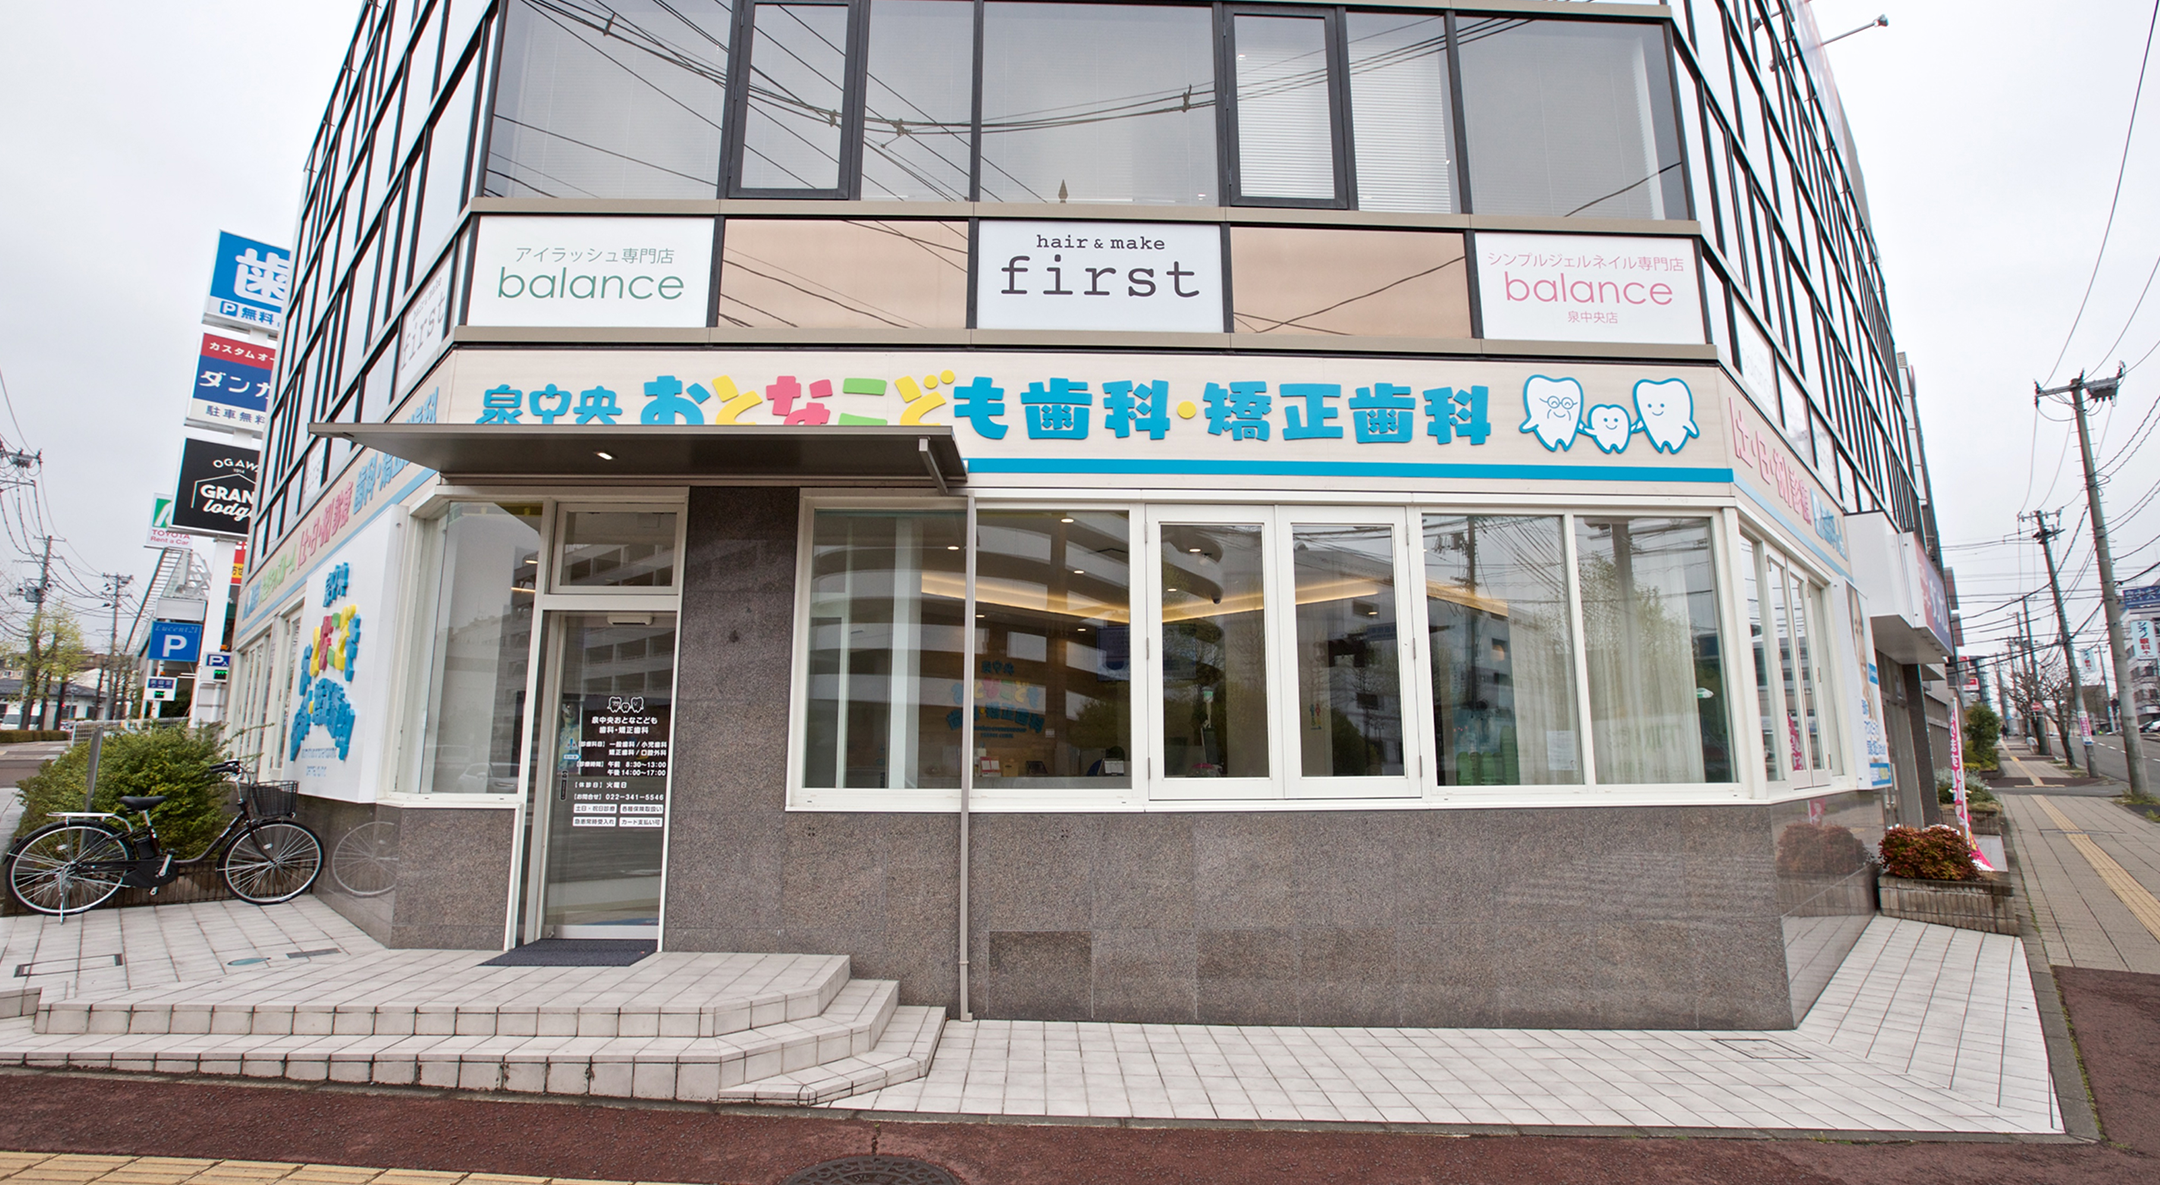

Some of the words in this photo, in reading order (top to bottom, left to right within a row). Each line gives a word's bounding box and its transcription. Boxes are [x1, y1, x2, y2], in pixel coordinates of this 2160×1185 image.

[1036, 234, 1088, 249] hair
[1093, 238, 1104, 249] &
[1110, 236, 1165, 250] make
[516, 247, 674, 264] アイラッシュ専門店
[1487, 252, 1684, 271] シンプルジェルネイル専門店
[498, 266, 684, 300] balance
[1001, 254, 1200, 298] first
[1504, 271, 1673, 306] balance
[241, 307, 281, 327] 無料
[1567, 311, 1618, 324] 泉中央店
[213, 458, 260, 473] OGAW
[162, 635, 188, 658] P
[209, 655, 225, 666] P
[591, 716, 658, 725] 泉中央おとなこども
[599, 726, 649, 735] 歯科・矯正歯科
[606, 781, 628, 789] 火曜日
